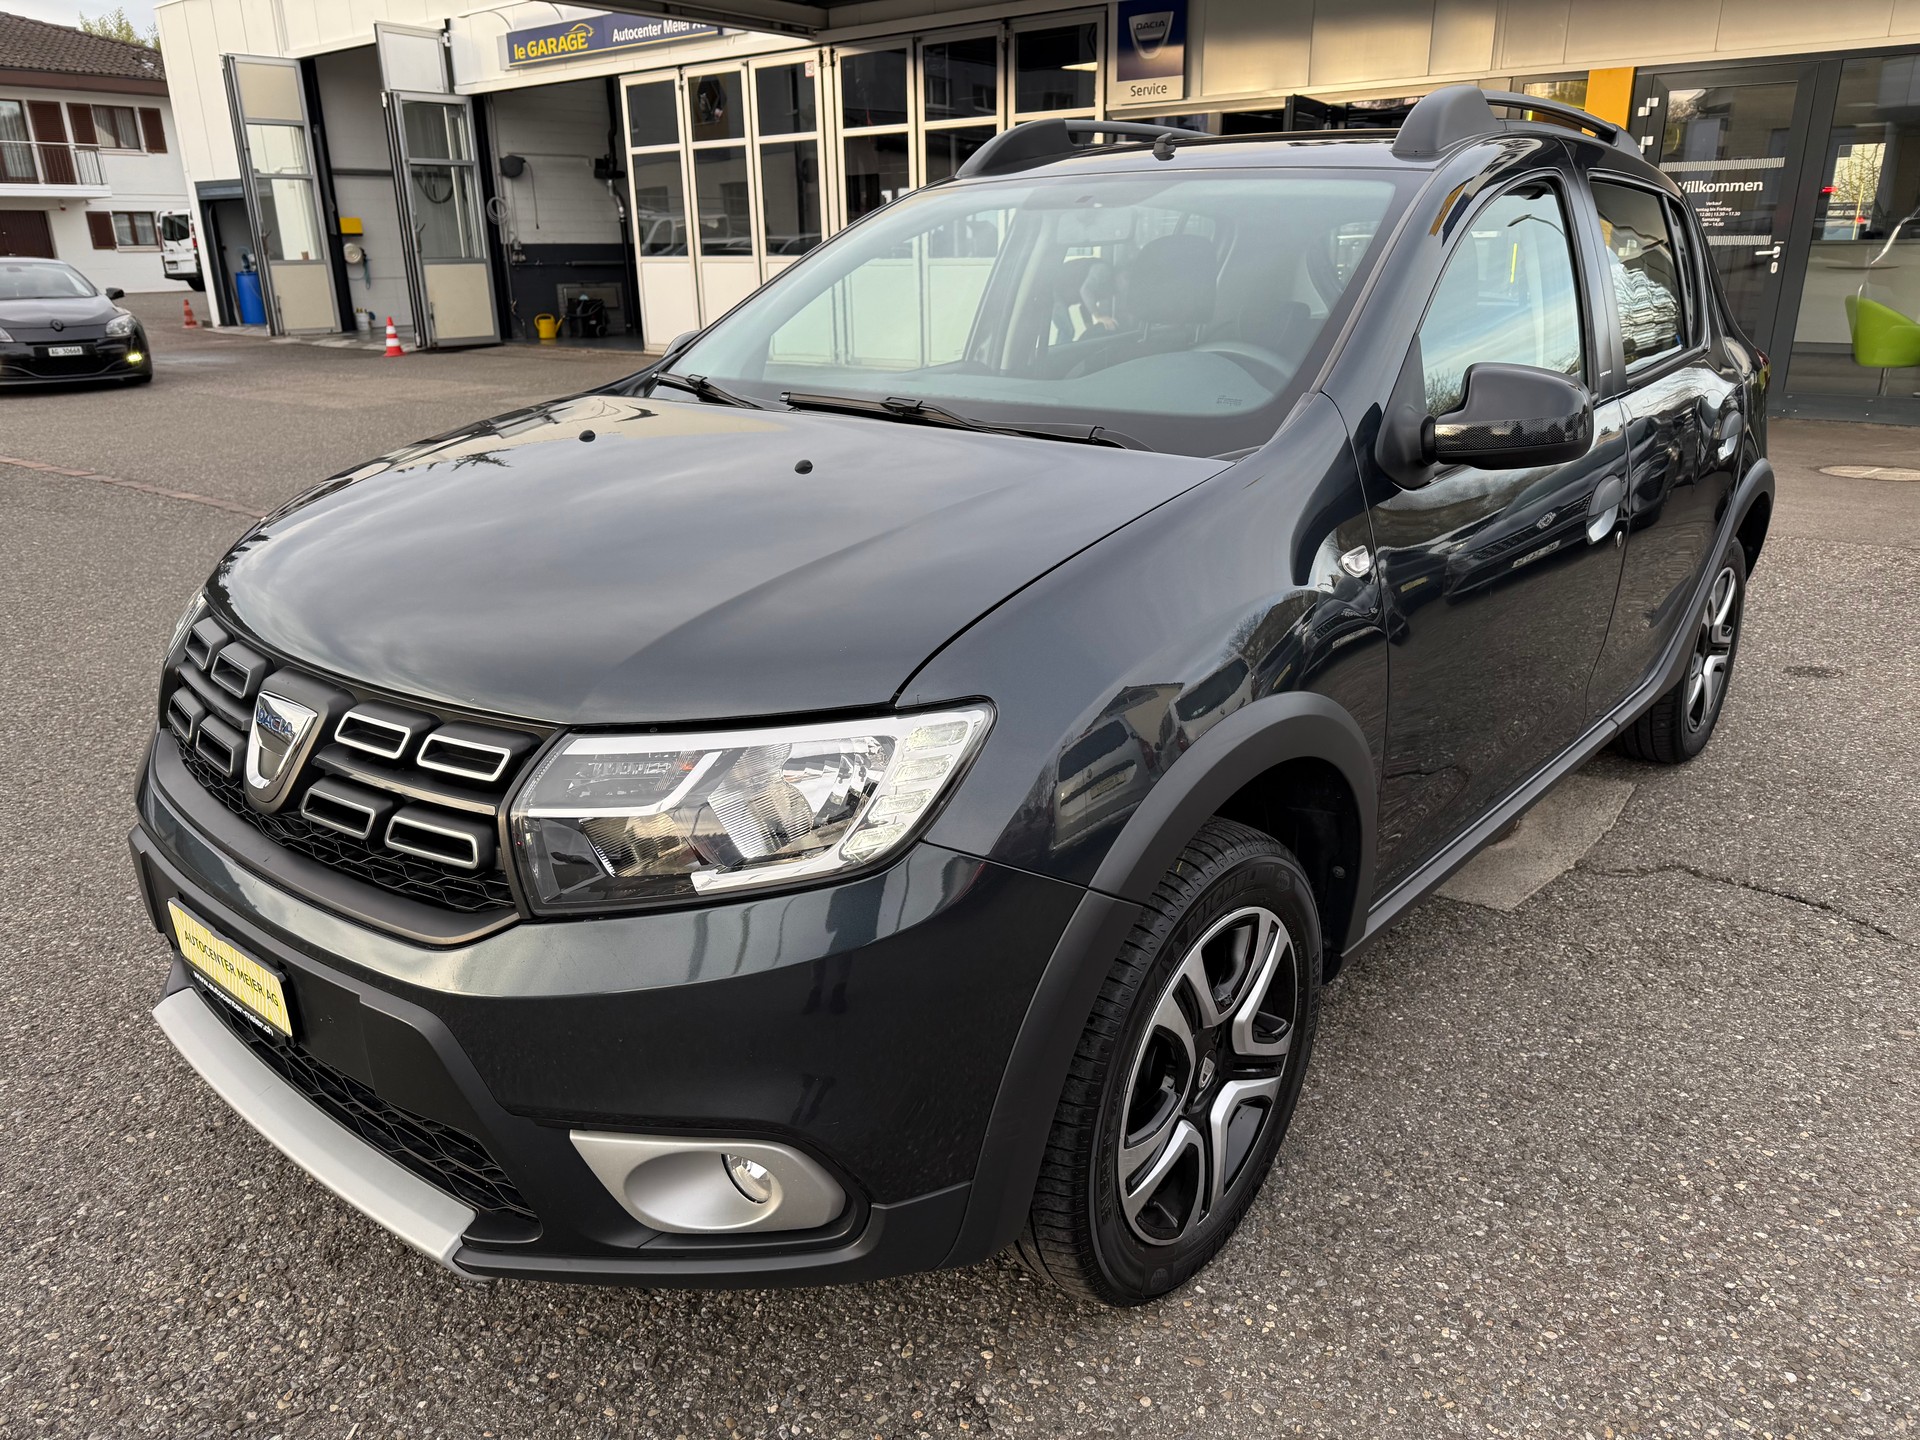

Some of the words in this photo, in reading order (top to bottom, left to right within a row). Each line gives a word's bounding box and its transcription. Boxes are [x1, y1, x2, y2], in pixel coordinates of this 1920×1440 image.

[612, 23, 662, 42] Autocenter
[1135, 20, 1165, 30] DACIA
[513, 43, 526, 60] le
[527, 32, 588, 57] GARAGE
[1130, 83, 1168, 97] Service
[256, 705, 295, 736] DACIA
[184, 930, 236, 977] AUTOCENTER
[236, 967, 265, 997] MEIER
[266, 989, 279, 1007] AG
